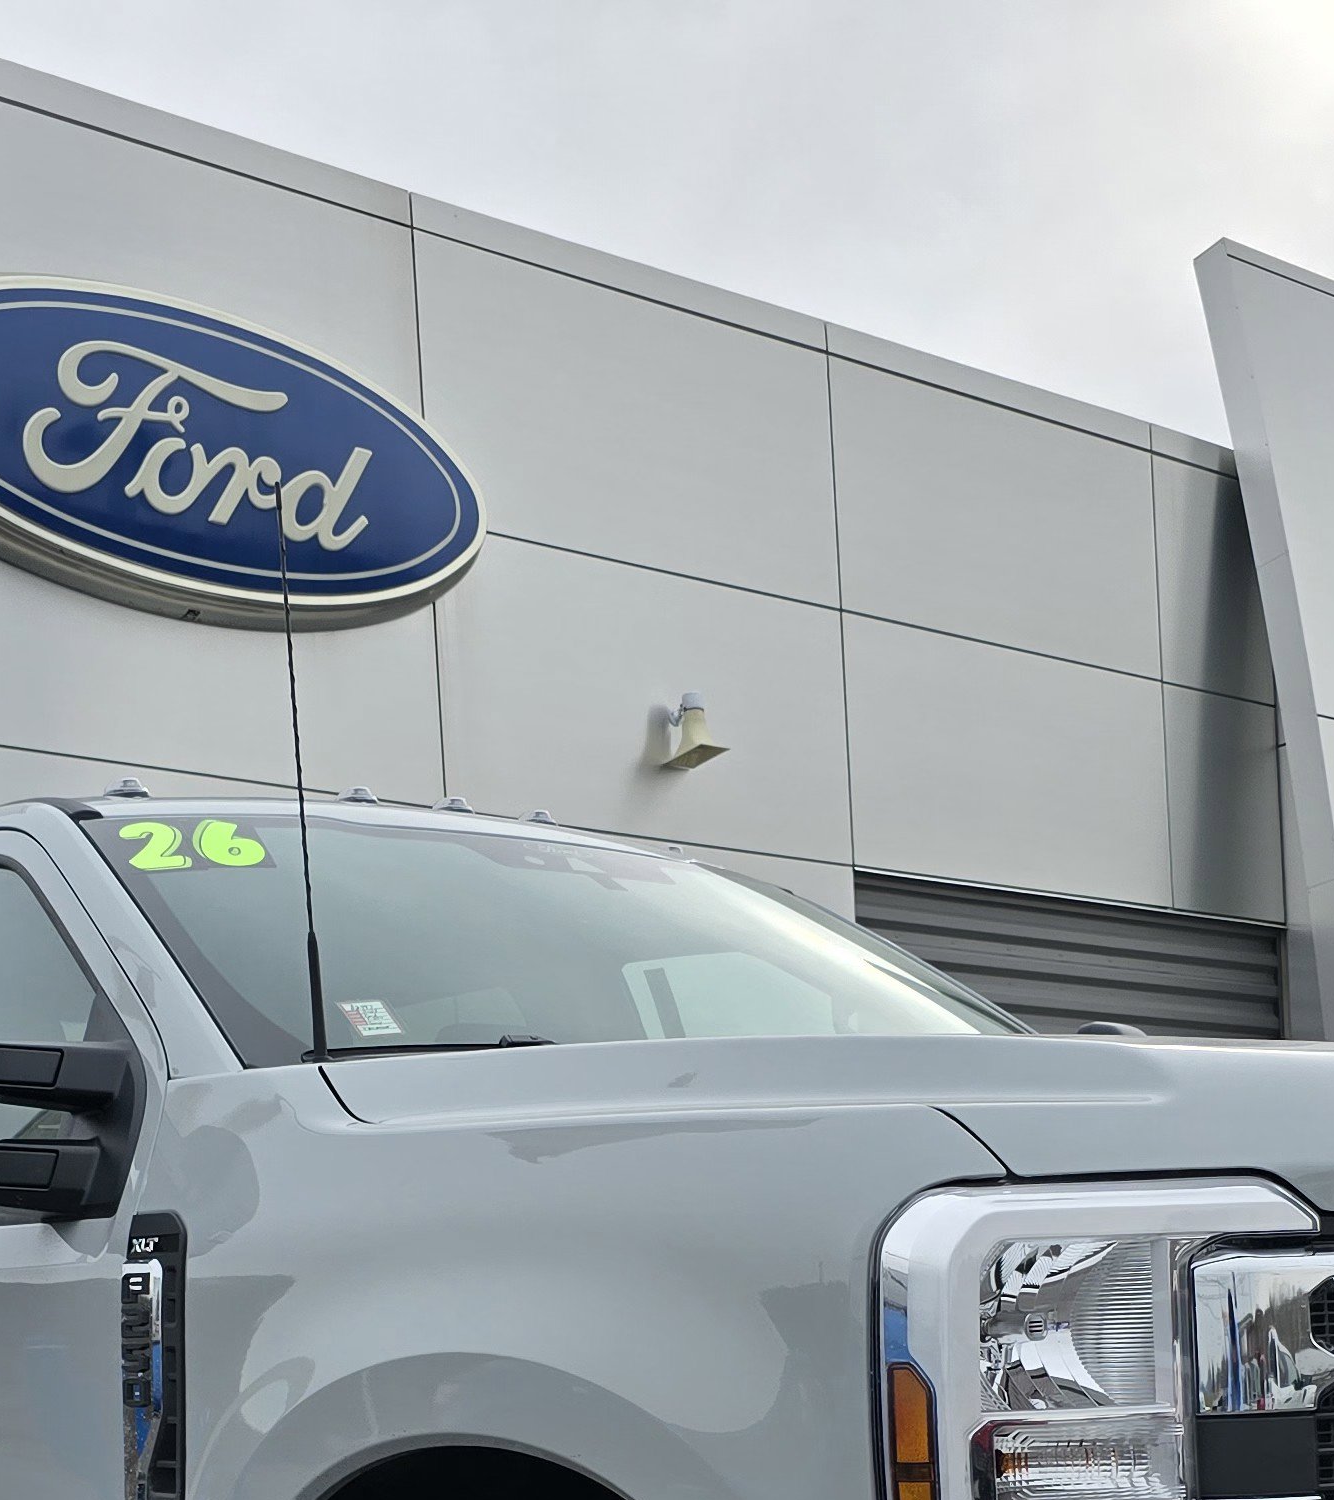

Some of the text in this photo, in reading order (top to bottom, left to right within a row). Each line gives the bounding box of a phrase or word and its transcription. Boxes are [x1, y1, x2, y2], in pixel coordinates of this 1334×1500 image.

[23, 340, 373, 552] Ford
[118, 820, 267, 871] 26
[131, 1237, 159, 1253] XLT
